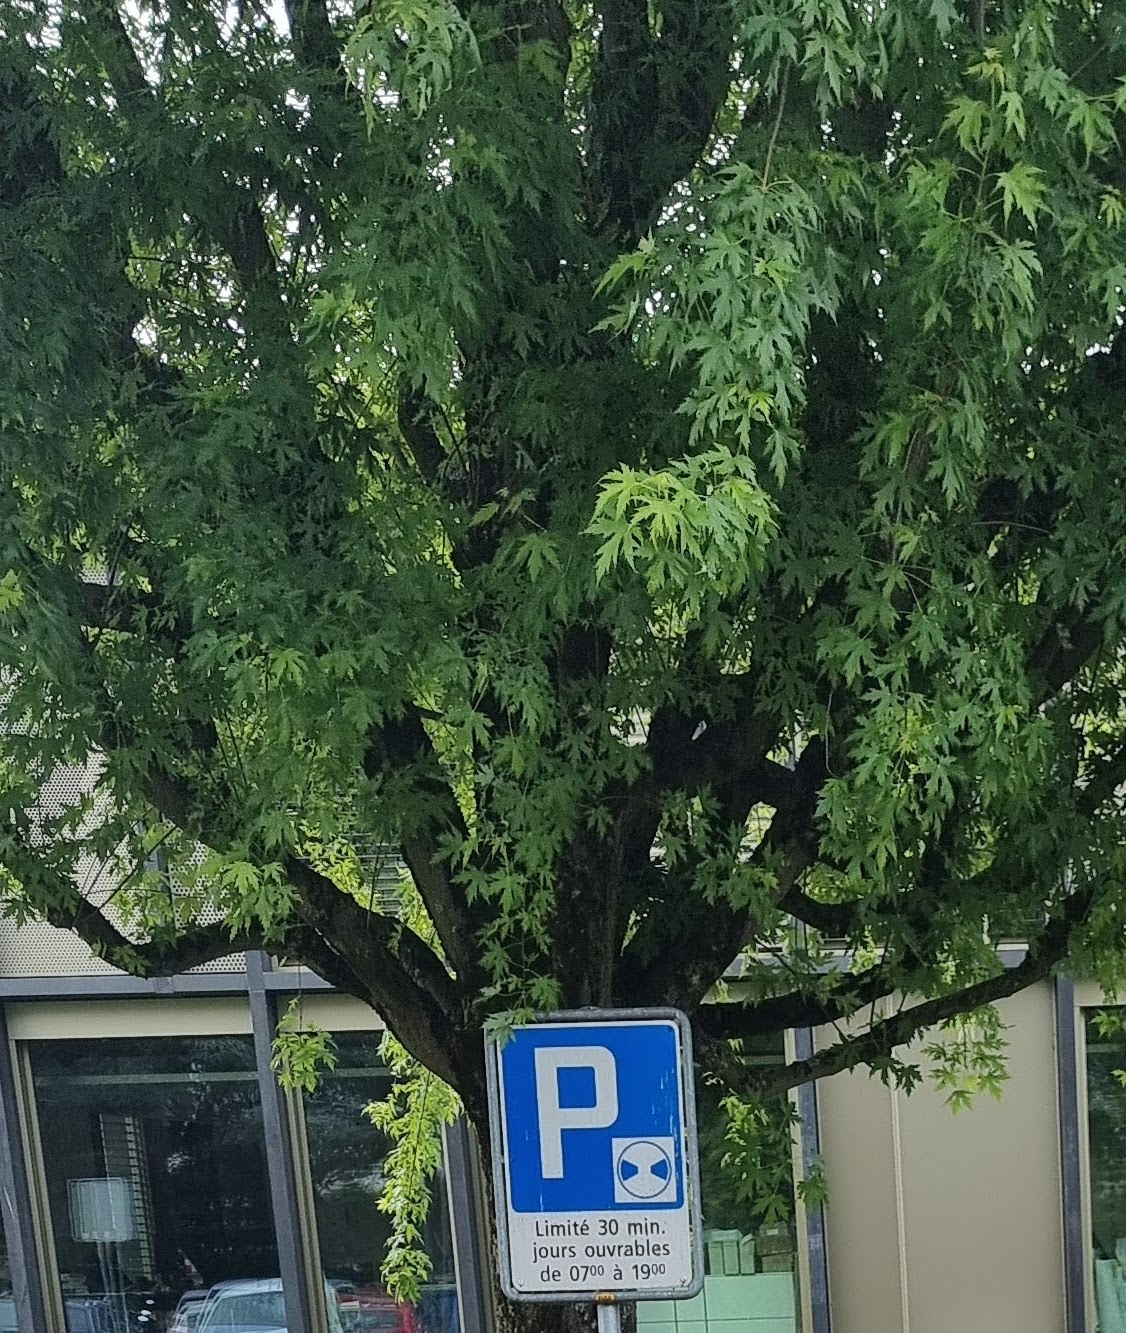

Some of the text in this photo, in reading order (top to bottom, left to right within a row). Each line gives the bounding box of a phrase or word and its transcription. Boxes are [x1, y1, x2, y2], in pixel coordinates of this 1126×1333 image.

[534, 1045, 619, 1179] P
[535, 1218, 665, 1237] Limité 30 min.
[533, 1239, 670, 1263] jours ouvrables
[540, 1265, 561, 1282] de
[613, 1264, 623, 1281] à
